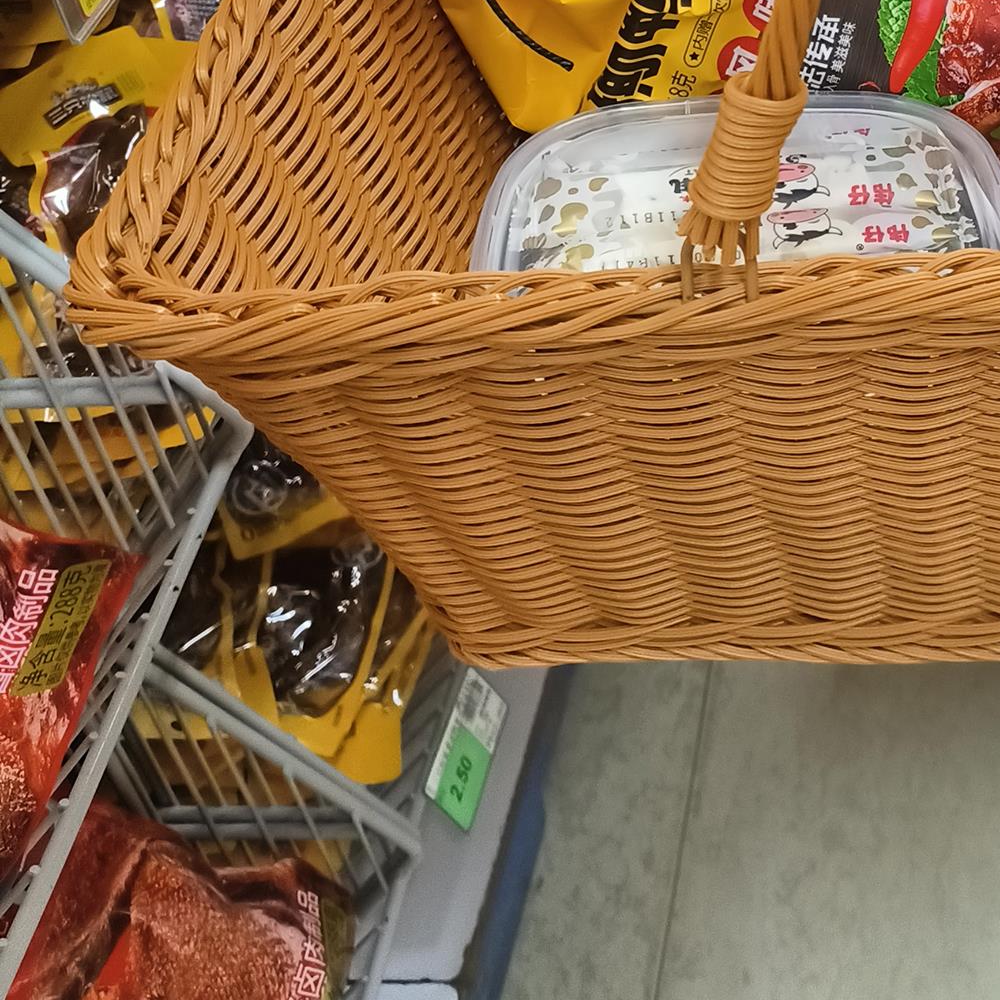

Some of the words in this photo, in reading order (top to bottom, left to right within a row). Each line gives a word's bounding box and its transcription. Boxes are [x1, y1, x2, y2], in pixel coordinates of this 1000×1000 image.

[799, 14, 840, 90] 法传承
[669, 70, 697, 98] 8克
[450, 755, 473, 802] 2.50
[288, 889, 327, 1000] 卤肉制品
